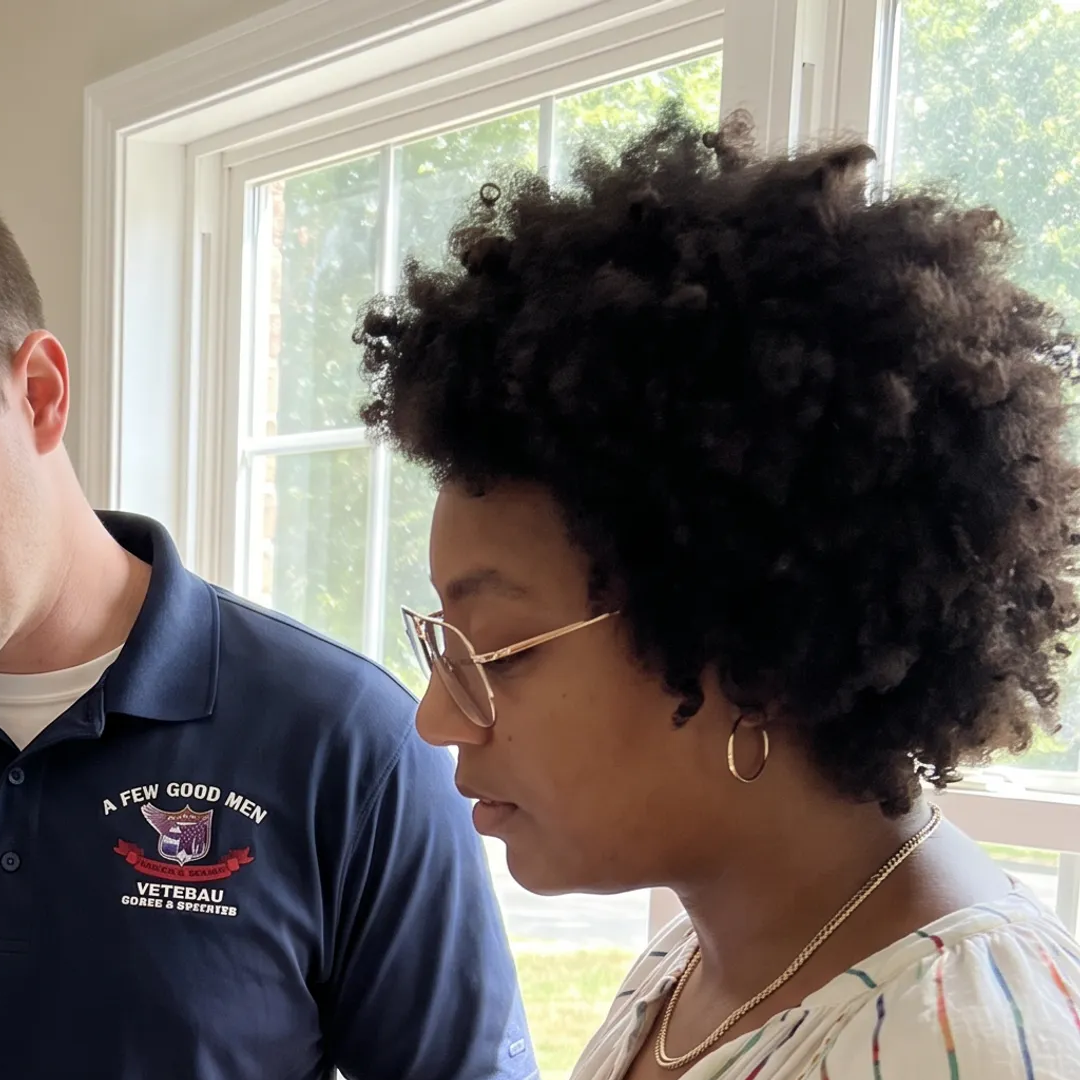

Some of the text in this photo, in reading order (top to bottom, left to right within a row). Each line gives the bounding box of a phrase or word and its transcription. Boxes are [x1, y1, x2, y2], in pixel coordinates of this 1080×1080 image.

[102, 799, 117, 816] A
[120, 783, 160, 807] FEW
[166, 782, 221, 802] GOOD
[224, 791, 268, 825] MEN
